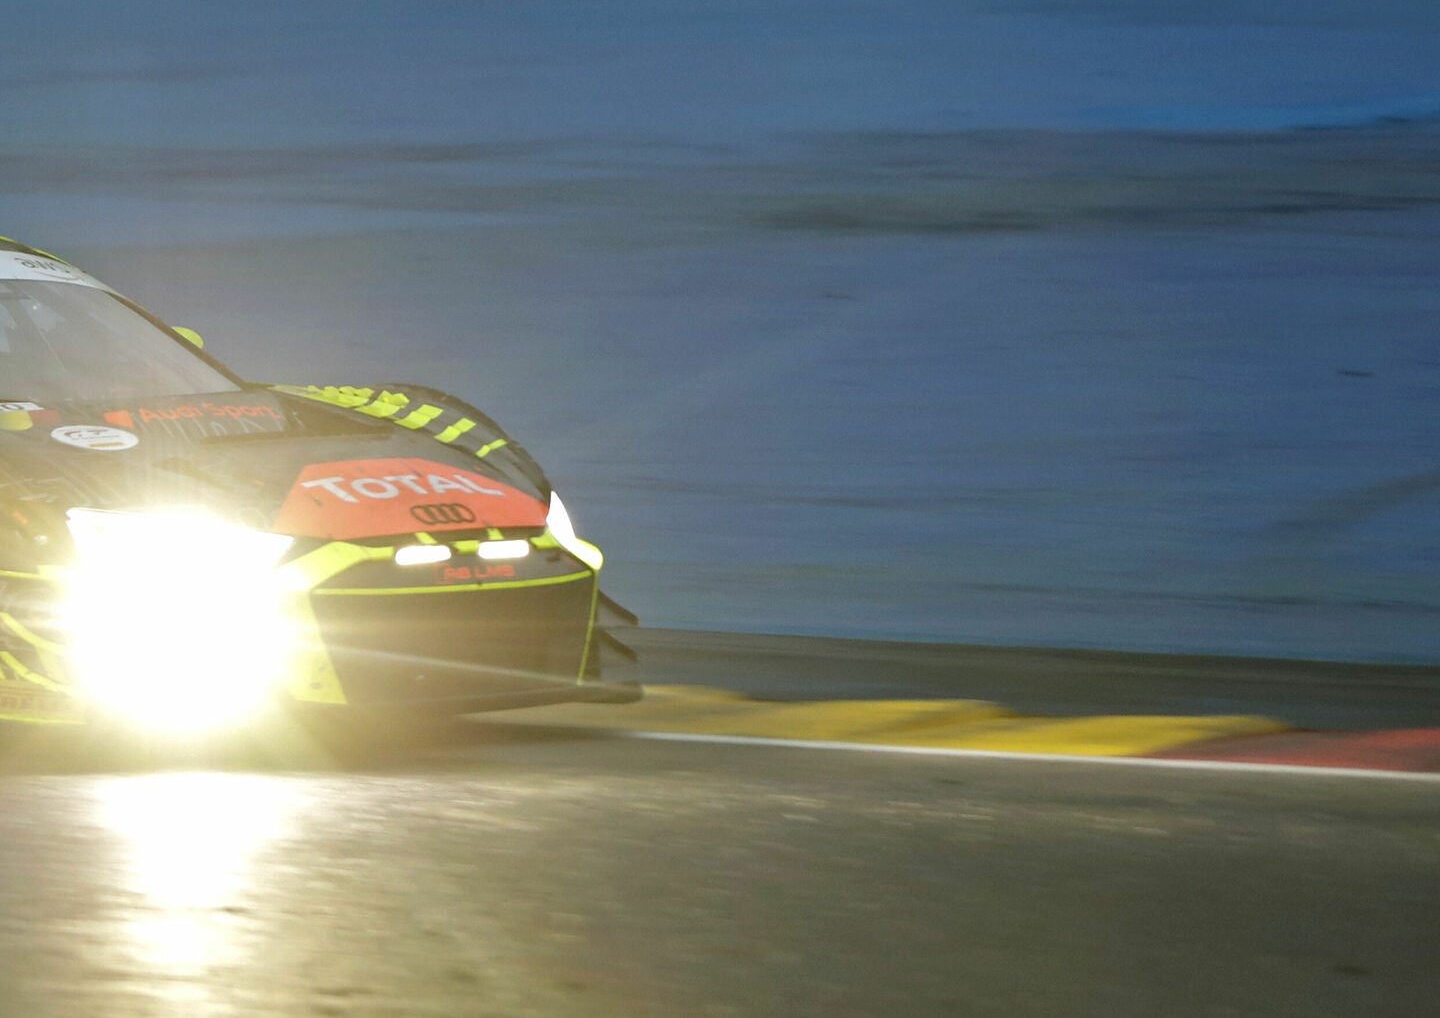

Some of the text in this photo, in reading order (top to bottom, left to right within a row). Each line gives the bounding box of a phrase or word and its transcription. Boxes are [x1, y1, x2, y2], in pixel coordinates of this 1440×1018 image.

[139, 403, 283, 423] Audi Sport
[301, 474, 505, 503] TOTAL
